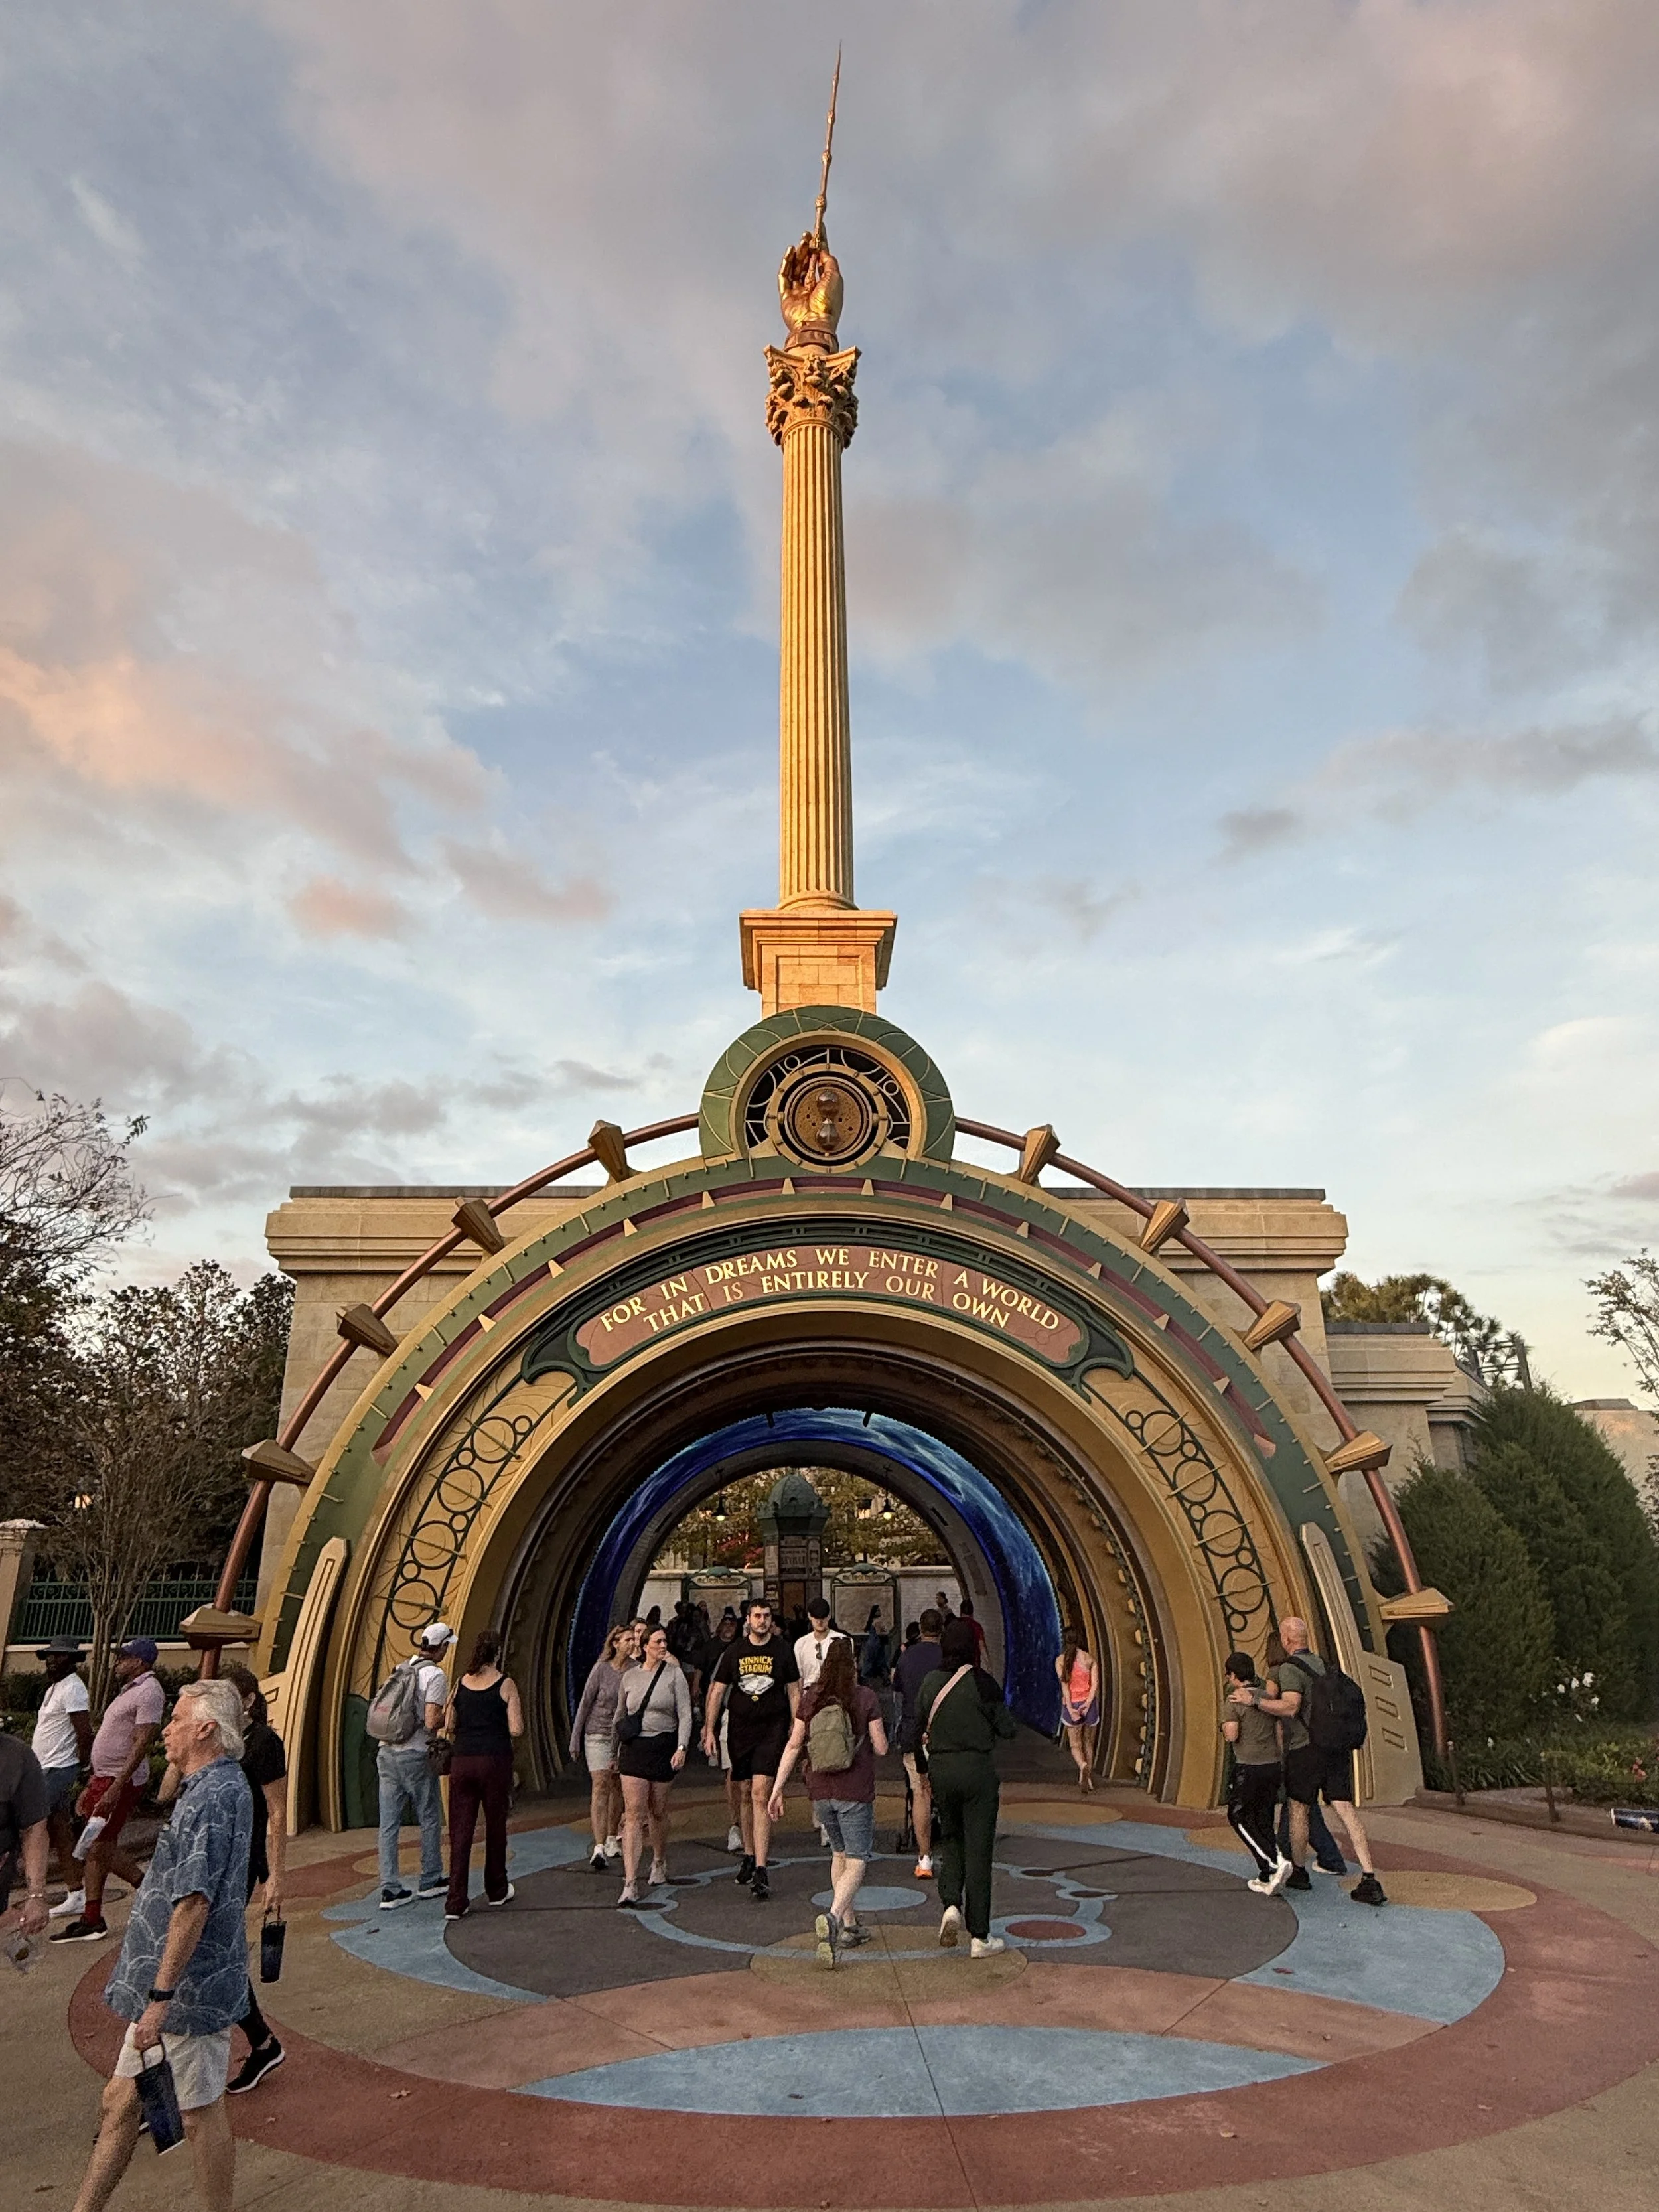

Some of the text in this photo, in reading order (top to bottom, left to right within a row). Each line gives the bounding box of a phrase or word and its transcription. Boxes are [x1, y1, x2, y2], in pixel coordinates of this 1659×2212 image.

[600, 1248, 1059, 1332] FOR IN DREAMS WE ENTER A WORLD
[643, 1270, 1011, 1332] THAT IS ENTIRELY OUR OWN
[739, 1656, 774, 1665] KINNICK
